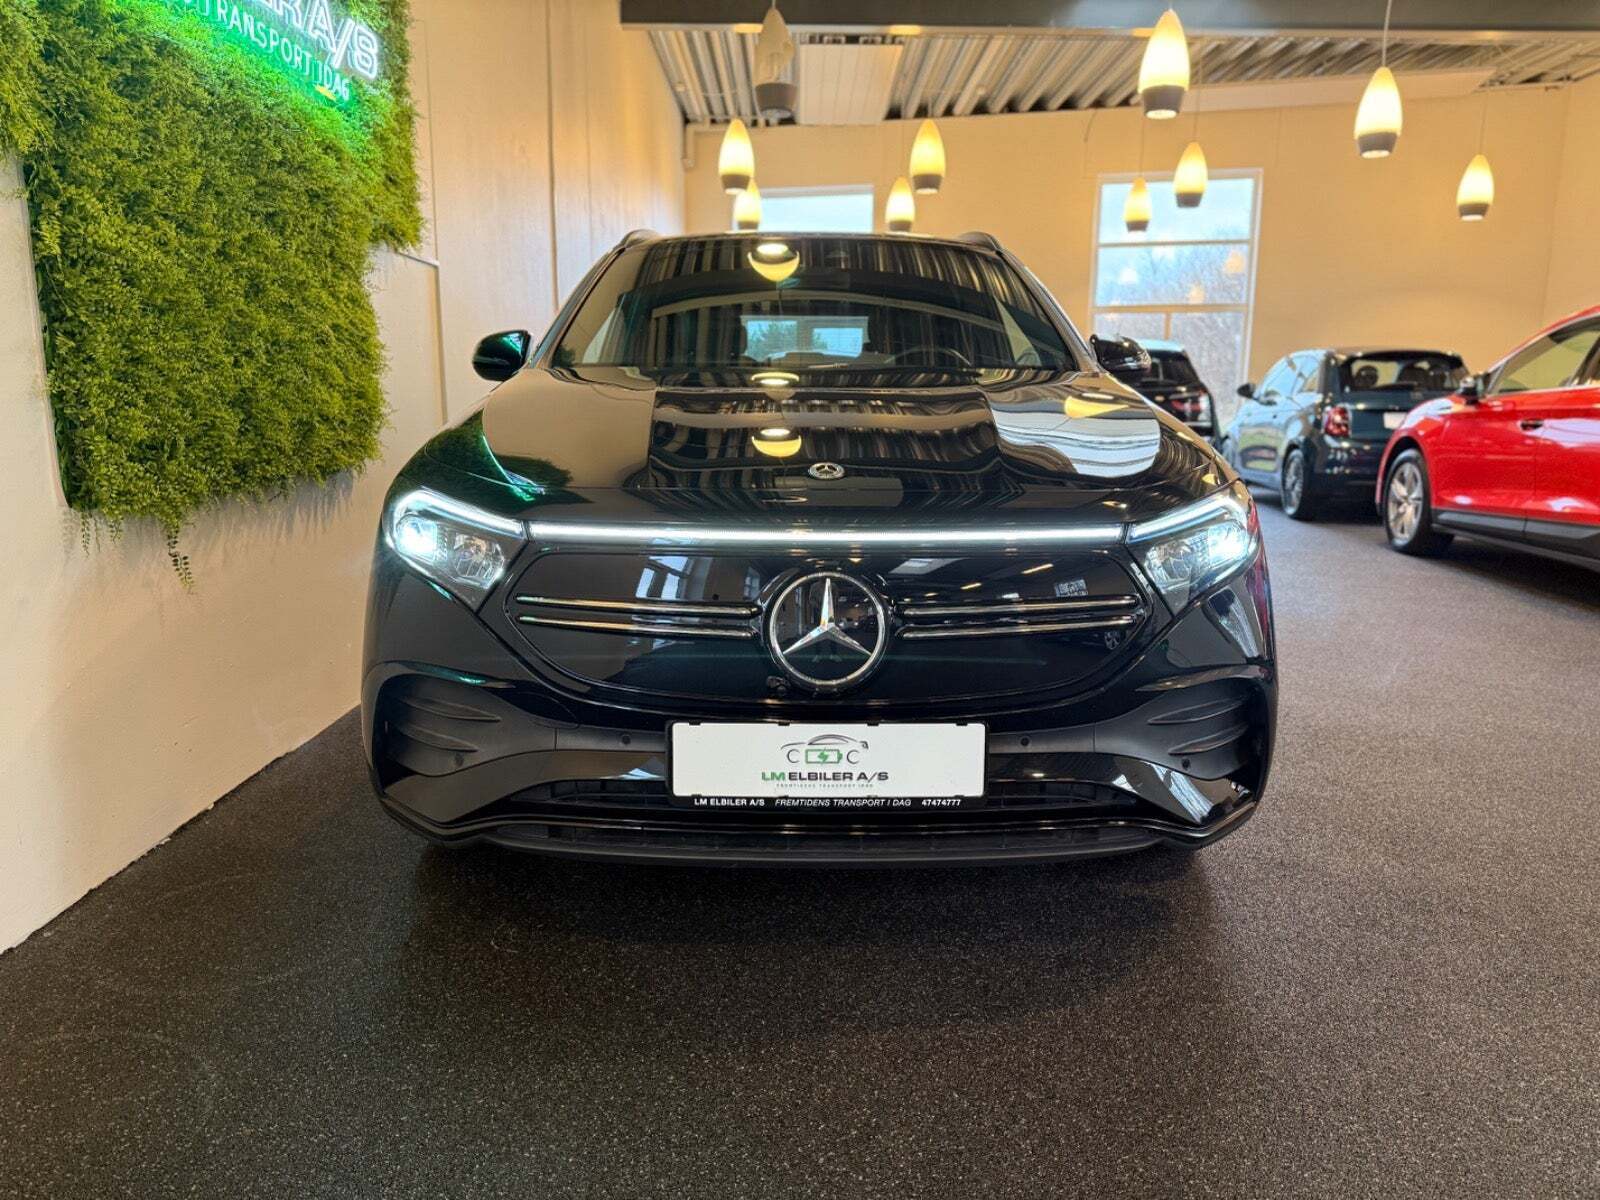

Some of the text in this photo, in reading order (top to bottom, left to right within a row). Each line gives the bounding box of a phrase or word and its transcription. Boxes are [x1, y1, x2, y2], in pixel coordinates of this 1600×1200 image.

[311, 0, 378, 79] A/S
[323, 65, 350, 101] DAG
[762, 772, 889, 783] LM ELBILER A/S
[694, 799, 708, 807] LM
[709, 799, 747, 807] ELBILER
[749, 799, 765, 807] A/S
[774, 799, 831, 807] FREMTIDENS
[833, 799, 886, 807] TRANSPORT
[892, 799, 912, 807] DAG
[921, 799, 962, 807] 47474777
